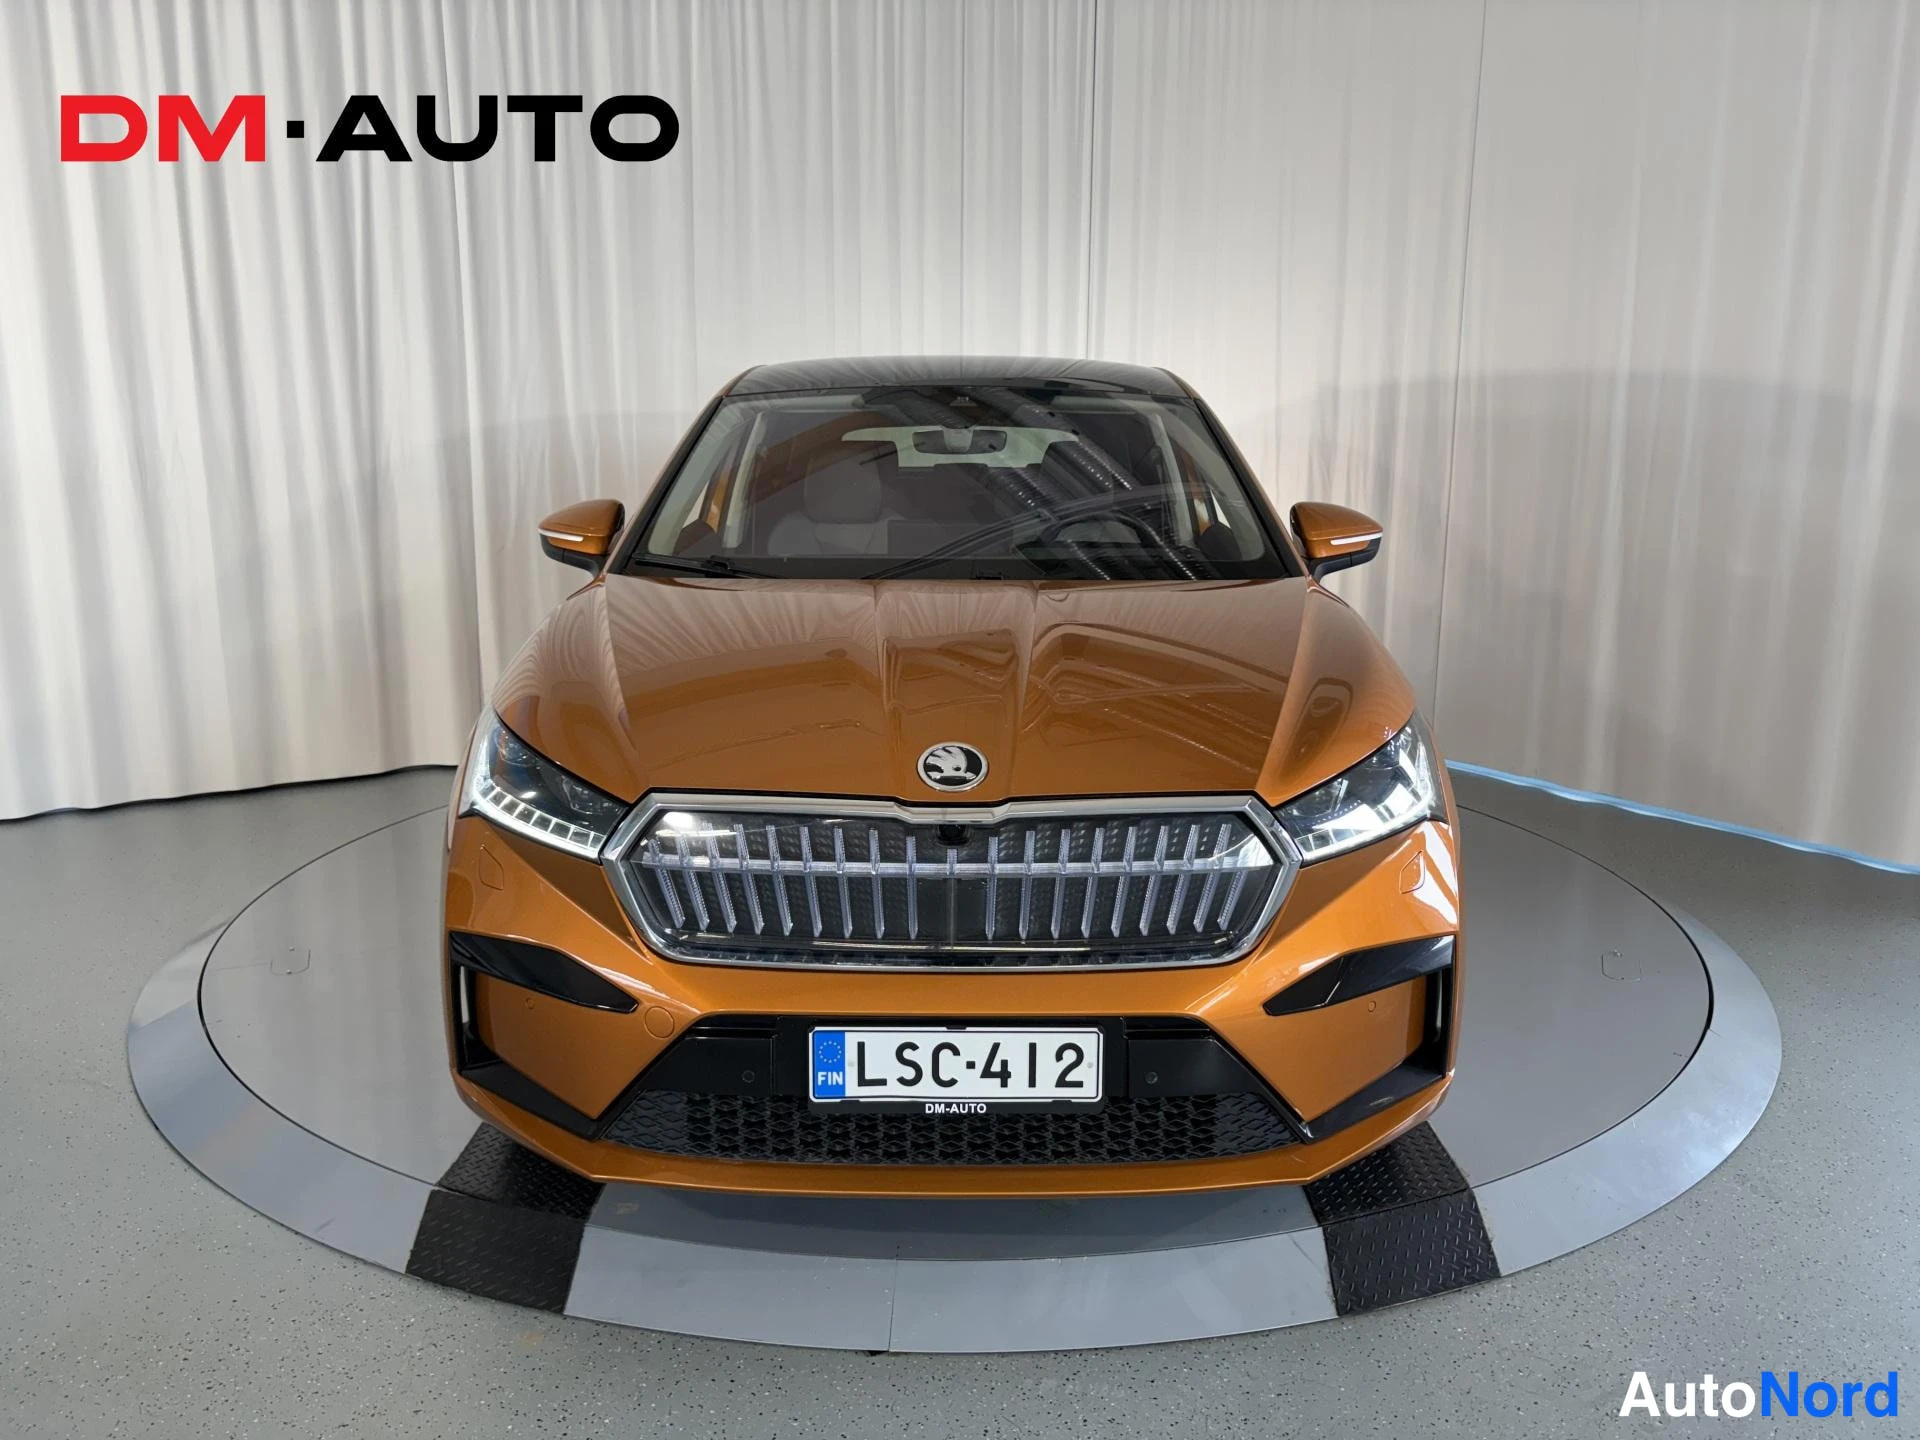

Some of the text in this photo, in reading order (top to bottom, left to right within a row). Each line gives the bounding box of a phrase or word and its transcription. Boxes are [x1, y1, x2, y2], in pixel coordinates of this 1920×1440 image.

[857, 1041, 1085, 1088] LSC-412
[817, 1071, 843, 1086] FIN
[925, 1103, 987, 1114] DM-AUTO
